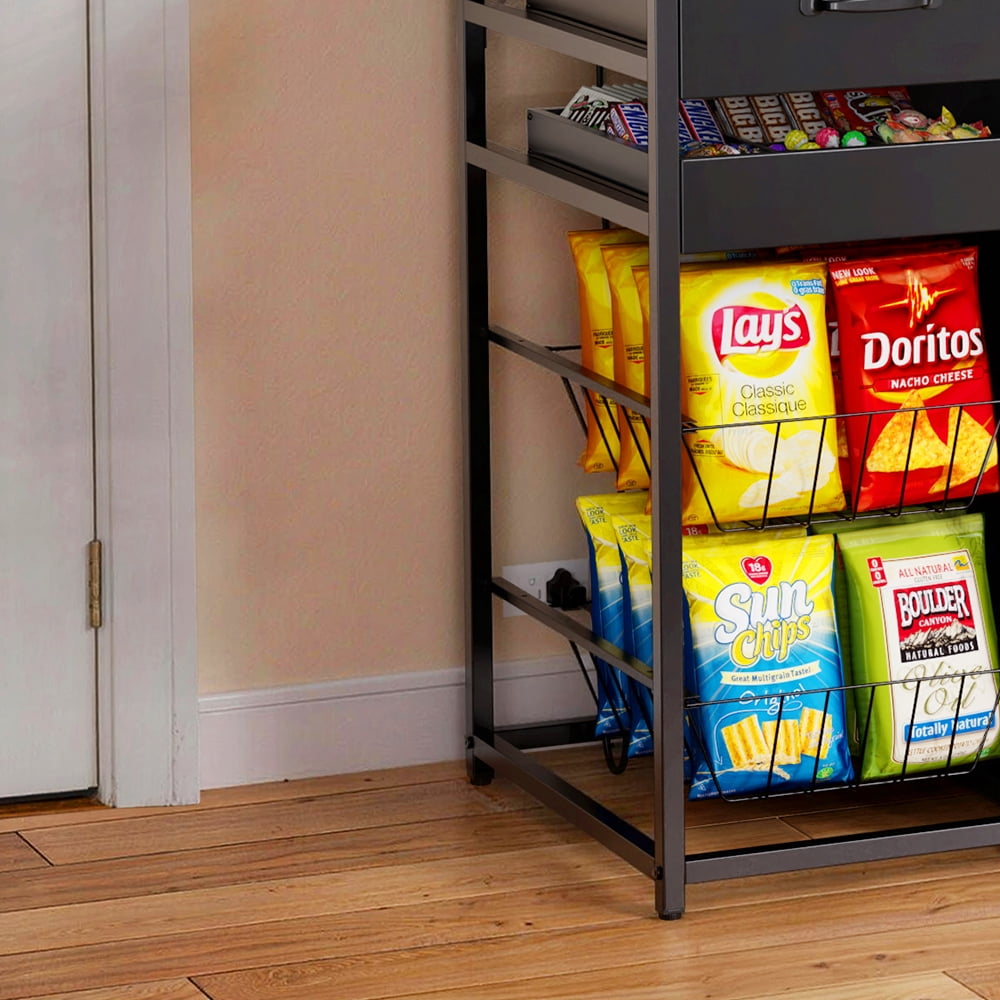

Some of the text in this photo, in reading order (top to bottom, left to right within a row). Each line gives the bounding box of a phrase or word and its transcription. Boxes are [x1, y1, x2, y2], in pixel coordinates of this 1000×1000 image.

[726, 96, 755, 126] BIG
[756, 96, 783, 125] BIG
[790, 92, 819, 122] BIG
[832, 267, 876, 280] NEW LOOK
[720, 304, 804, 356] Lay's
[860, 323, 984, 370] Doritos
[891, 369, 974, 389] NACHO CHEESE
[740, 382, 795, 399] Classic
[732, 399, 807, 417] Classique
[872, 559, 878, 567] 0
[899, 562, 955, 578] ALL NATURAL
[682, 571, 701, 579] ASTE
[875, 572, 881, 580] 0
[715, 580, 814, 644] Sun
[897, 584, 970, 628] BOULDER
[919, 616, 953, 627] CANYON
[906, 641, 975, 660] NATURAL FOODS
[751, 672, 791, 682] Multigrain
[791, 667, 812, 677] Taste!
[902, 661, 982, 691] Olive
[911, 723, 948, 738] Totally
